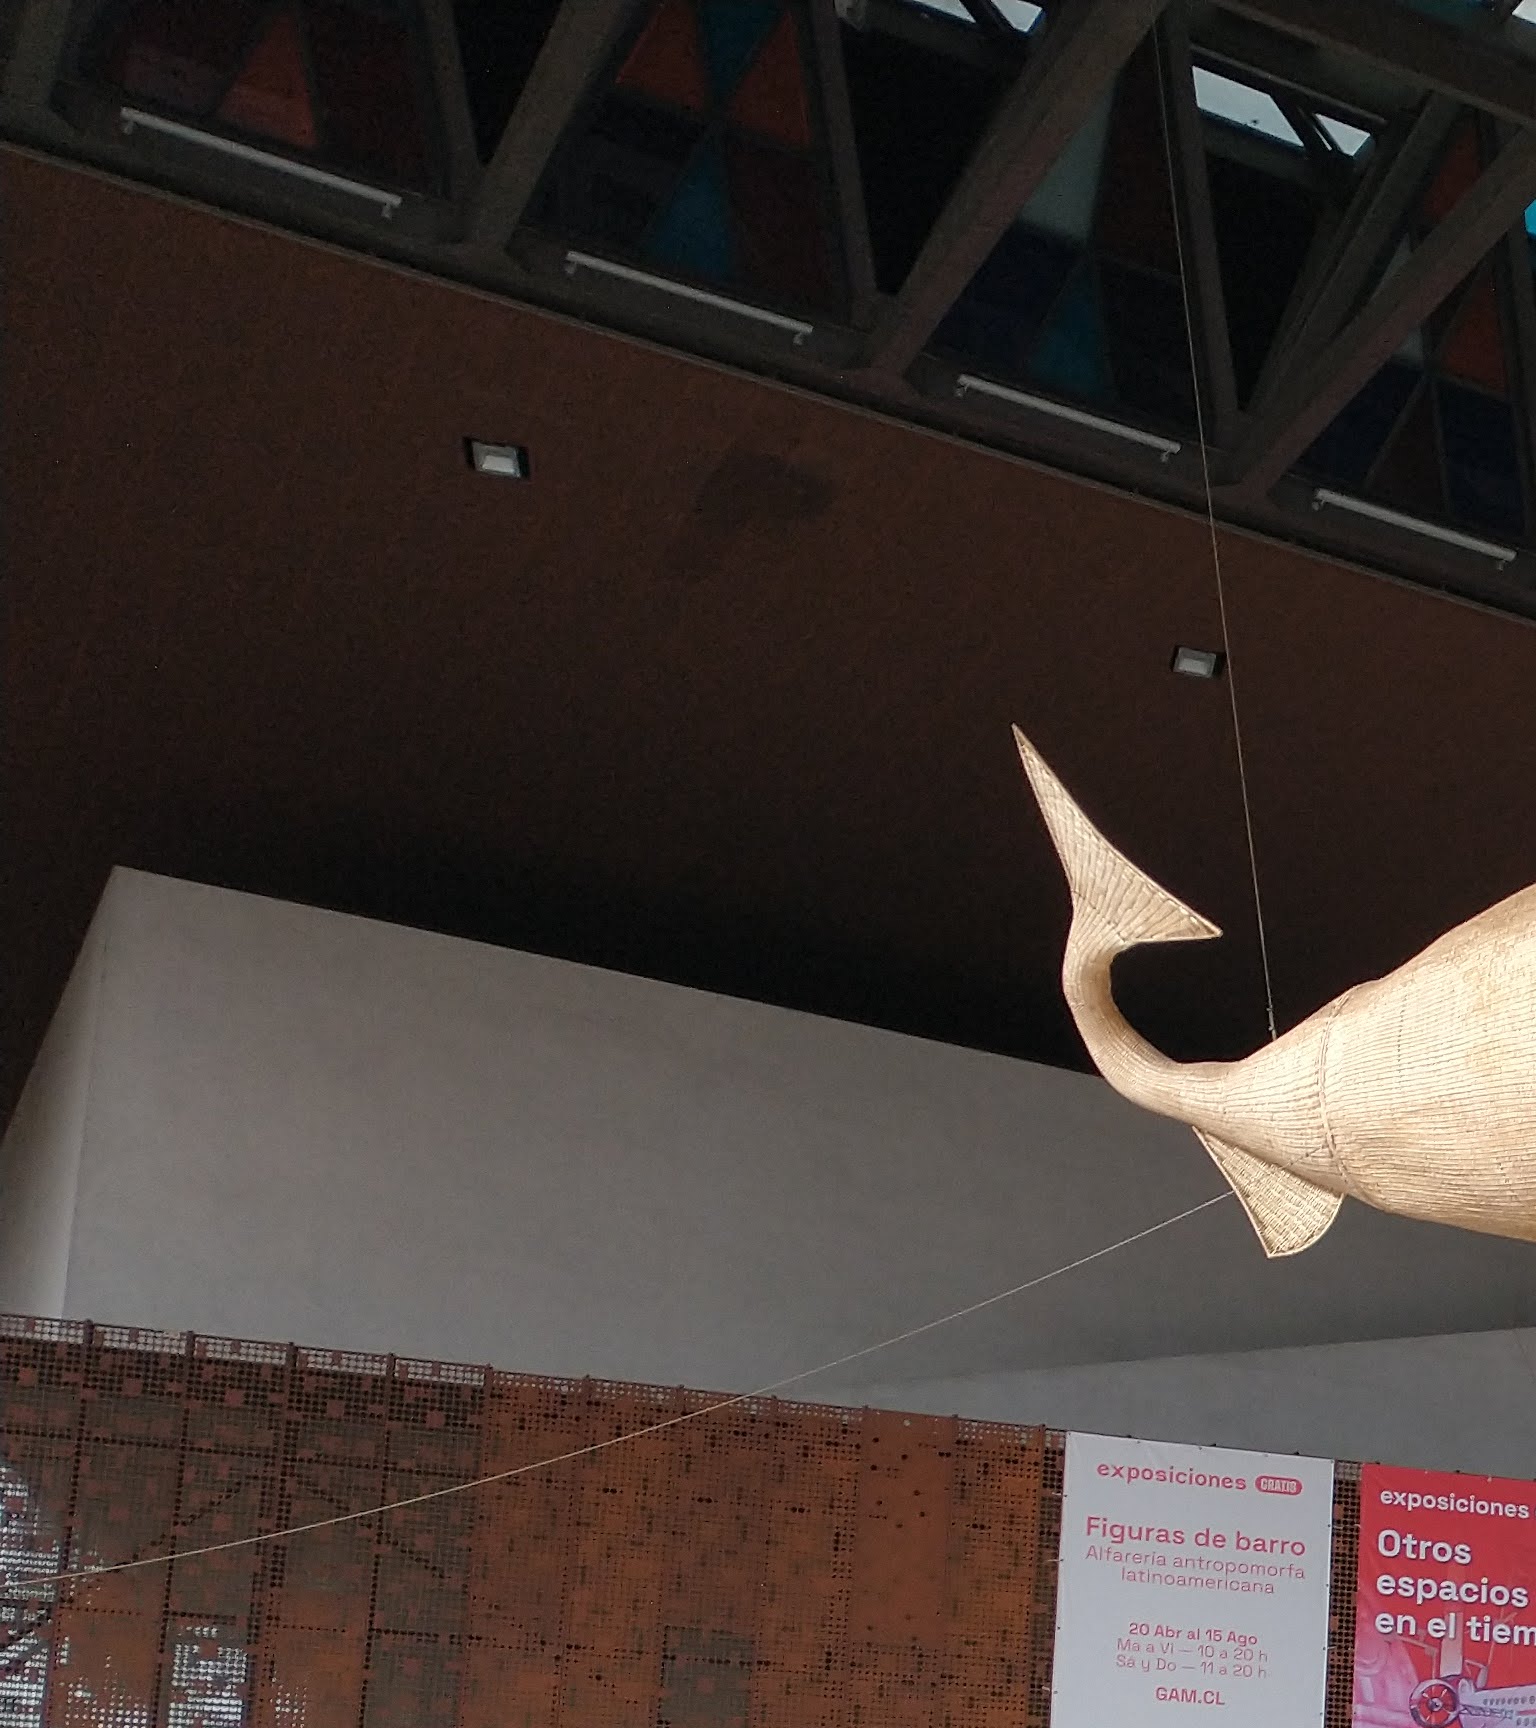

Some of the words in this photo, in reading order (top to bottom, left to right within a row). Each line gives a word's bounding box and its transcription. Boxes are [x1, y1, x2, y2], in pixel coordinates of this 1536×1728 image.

[1097, 1463, 1247, 1490] exposiciones
[1260, 1478, 1297, 1492] GRATIS
[1380, 1489, 1529, 1519] exposiciones
[1086, 1516, 1185, 1544] Figuras
[1194, 1528, 1226, 1548] de
[1235, 1531, 1306, 1556] barro
[1377, 1529, 1472, 1565] Otros
[1121, 1567, 1274, 1594] latinoamericana
[1173, 1555, 1305, 1579] antropomorfa
[1376, 1573, 1529, 1608] espacios
[1129, 1622, 1149, 1636] 20
[1154, 1625, 1182, 1638] Abr
[1187, 1628, 1200, 1639] al
[1206, 1629, 1222, 1642] 15
[1227, 1631, 1257, 1647] Ago
[1375, 1612, 1416, 1635] en
[1427, 1612, 1456, 1639] el
[1117, 1638, 1140, 1652] Ma
[1145, 1643, 1155, 1653] a
[1160, 1643, 1174, 1654] Vi
[1197, 1645, 1215, 1658] 10
[1219, 1650, 1228, 1659] a
[1233, 1648, 1253, 1661] 20
[1258, 1649, 1268, 1662] h
[1141, 1660, 1150, 1672] y
[1156, 1658, 1177, 1671] Do
[1201, 1662, 1213, 1674] 11
[1219, 1666, 1228, 1675] a
[1233, 1664, 1252, 1678] 20
[1258, 1665, 1267, 1678] h
[1156, 1686, 1226, 1705] GAM.CL
